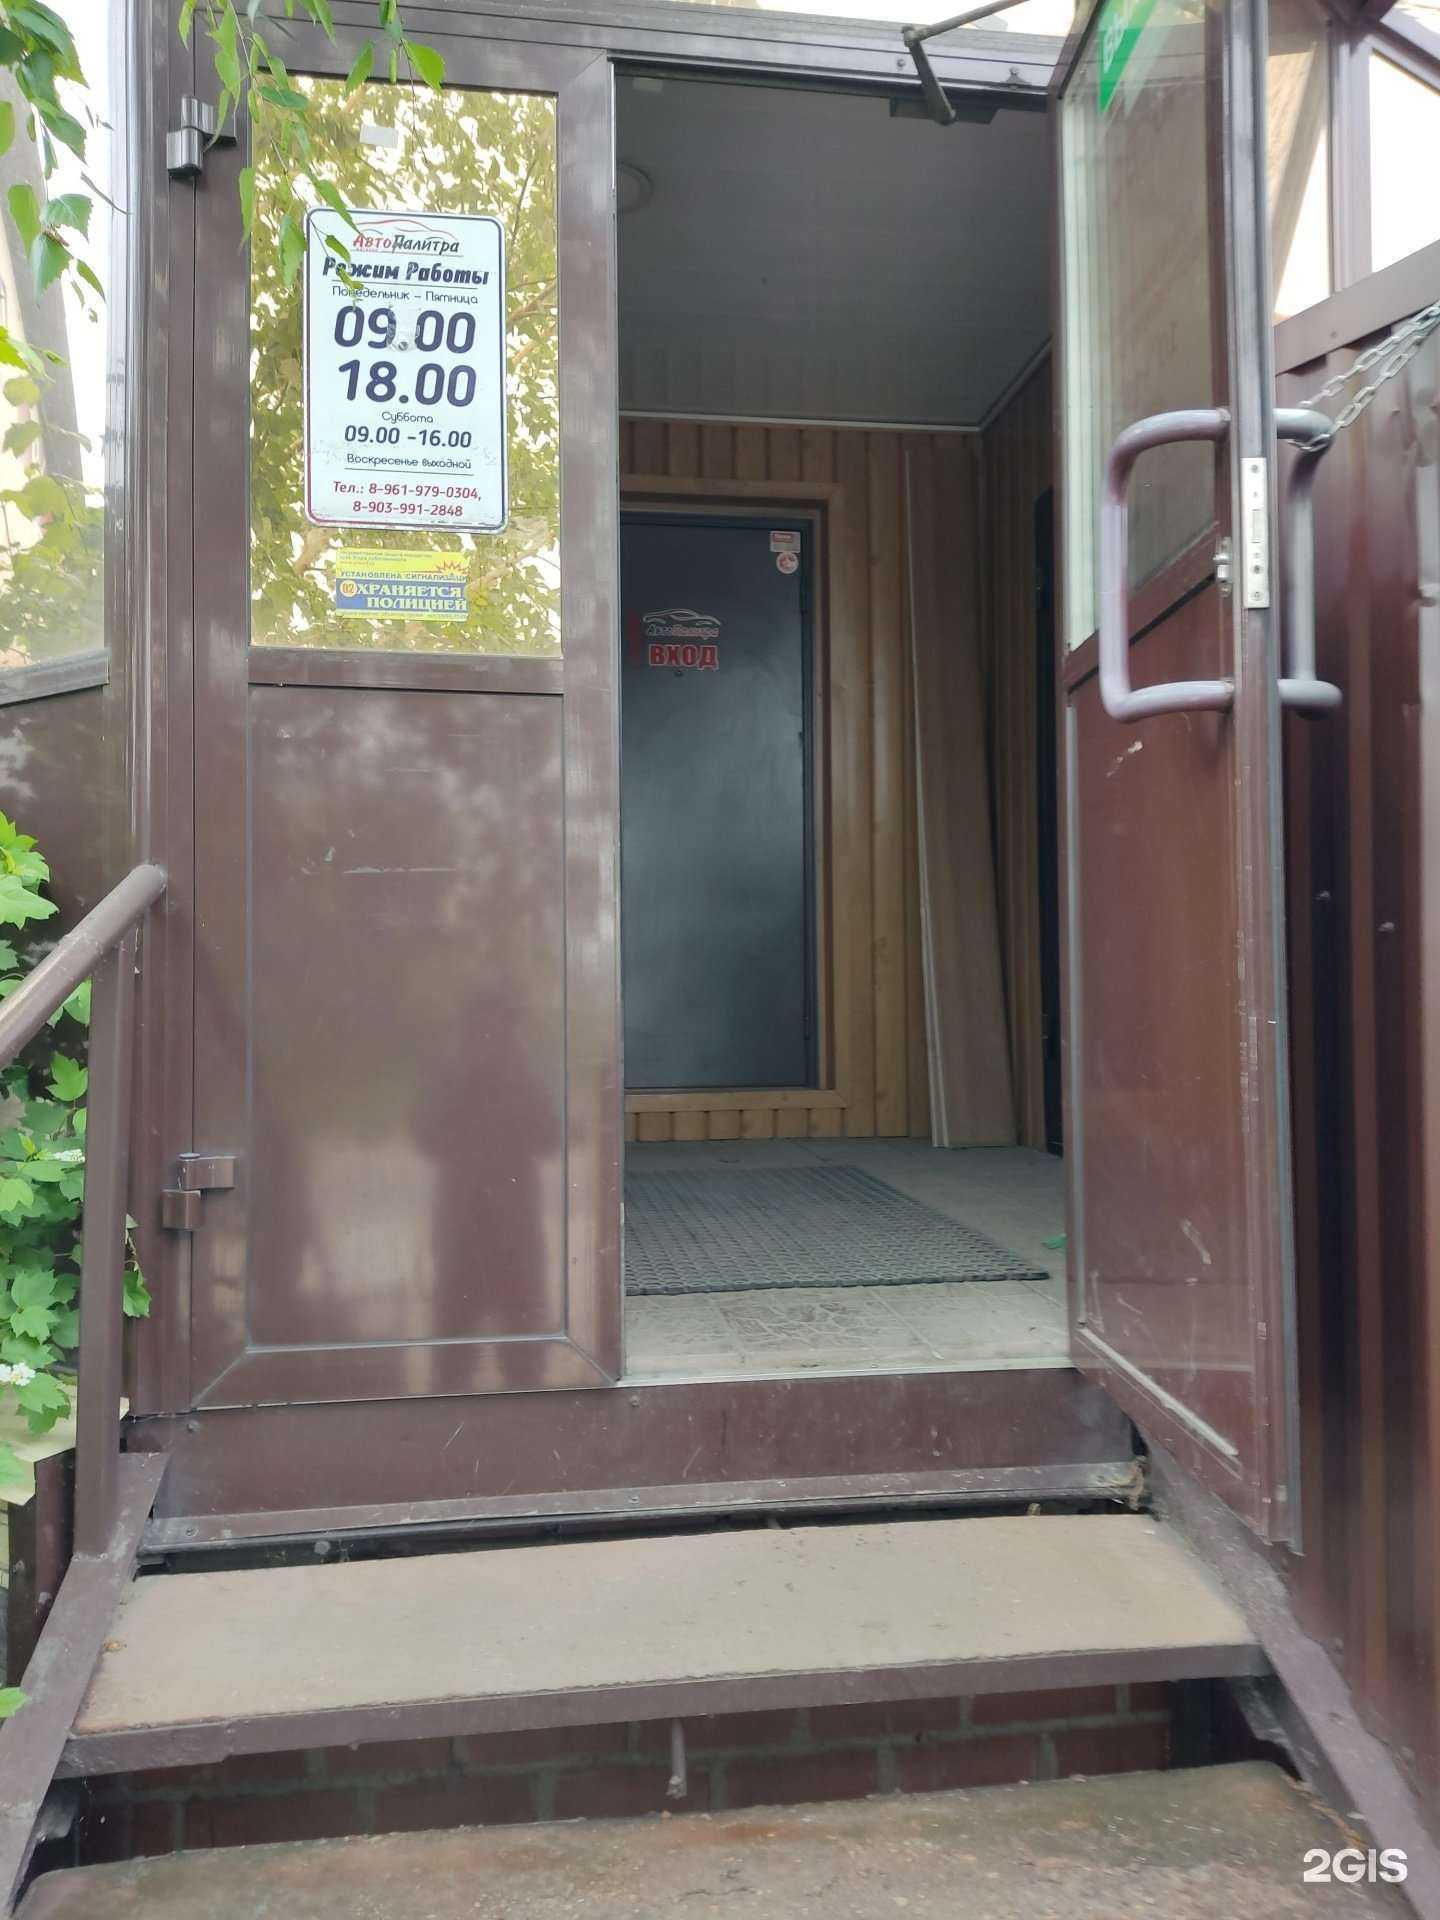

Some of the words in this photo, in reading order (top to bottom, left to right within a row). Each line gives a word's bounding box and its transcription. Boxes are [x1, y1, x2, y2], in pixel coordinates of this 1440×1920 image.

[352, 233, 461, 256] АвтоПалитра
[405, 261, 490, 286] Работы
[331, 285, 410, 302] Понедельник
[425, 291, 479, 306] Пятница
[333, 305, 477, 355] 09.00
[338, 359, 478, 408] 18.00
[381, 411, 434, 425] Суббота
[344, 425, 400, 445] 09.00
[346, 453, 419, 468] Воскресенье
[421, 457, 472, 470] выходной
[333, 481, 365, 495] Тел.:
[368, 483, 482, 502] 8-961-979-0304,
[352, 501, 464, 518] 8-903-991-2848
[367, 597, 468, 611] ПОЛИЦИЕЙ
[649, 644, 719, 670] ВХОД
